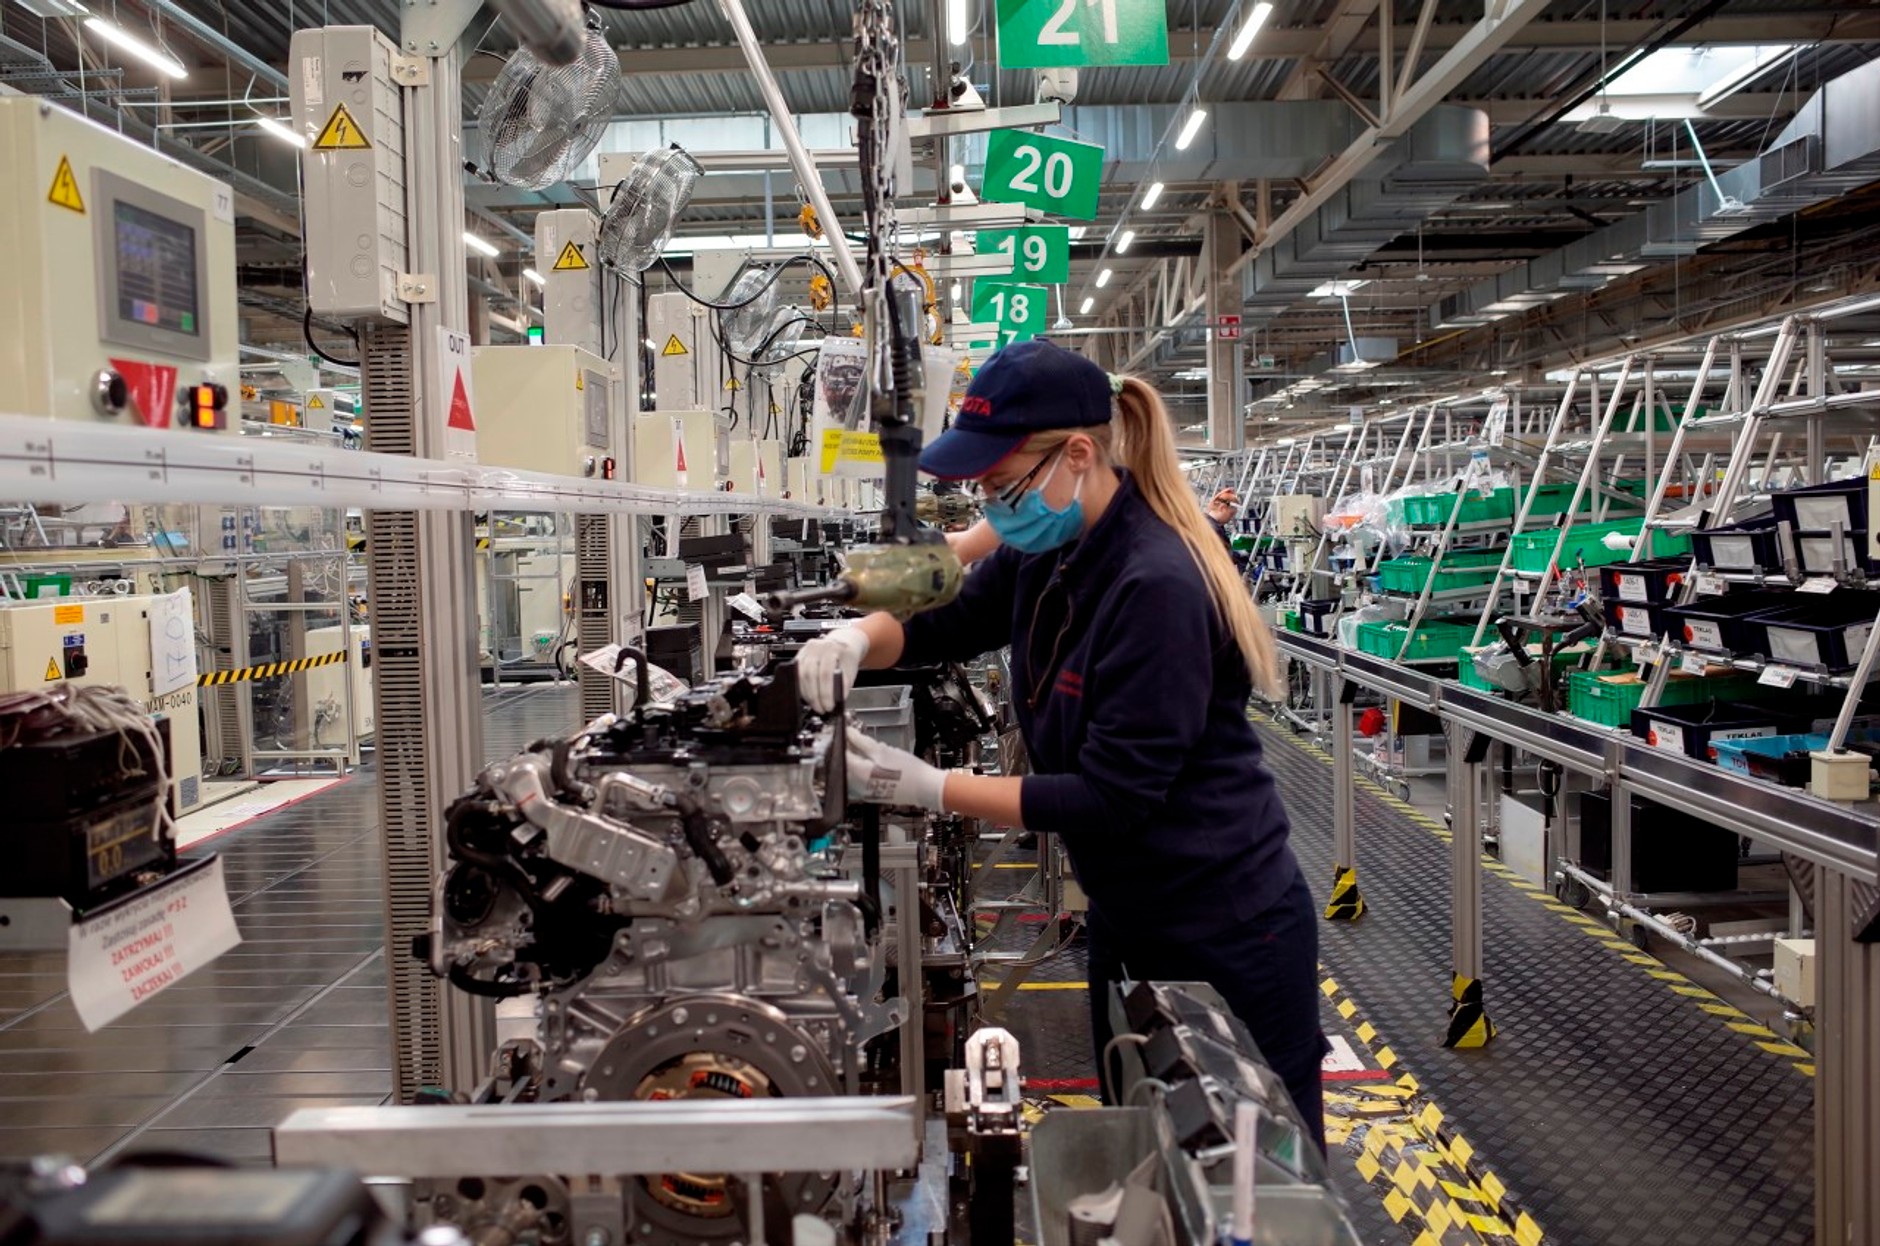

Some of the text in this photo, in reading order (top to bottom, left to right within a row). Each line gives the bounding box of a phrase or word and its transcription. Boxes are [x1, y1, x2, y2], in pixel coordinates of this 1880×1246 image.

[1037, 0, 1118, 45] 21
[1009, 145, 1074, 198] 20
[998, 235, 1047, 271] 19
[990, 292, 1029, 323] 18
[449, 334, 464, 356] OUT
[111, 930, 163, 966] ZATRZYMAJ
